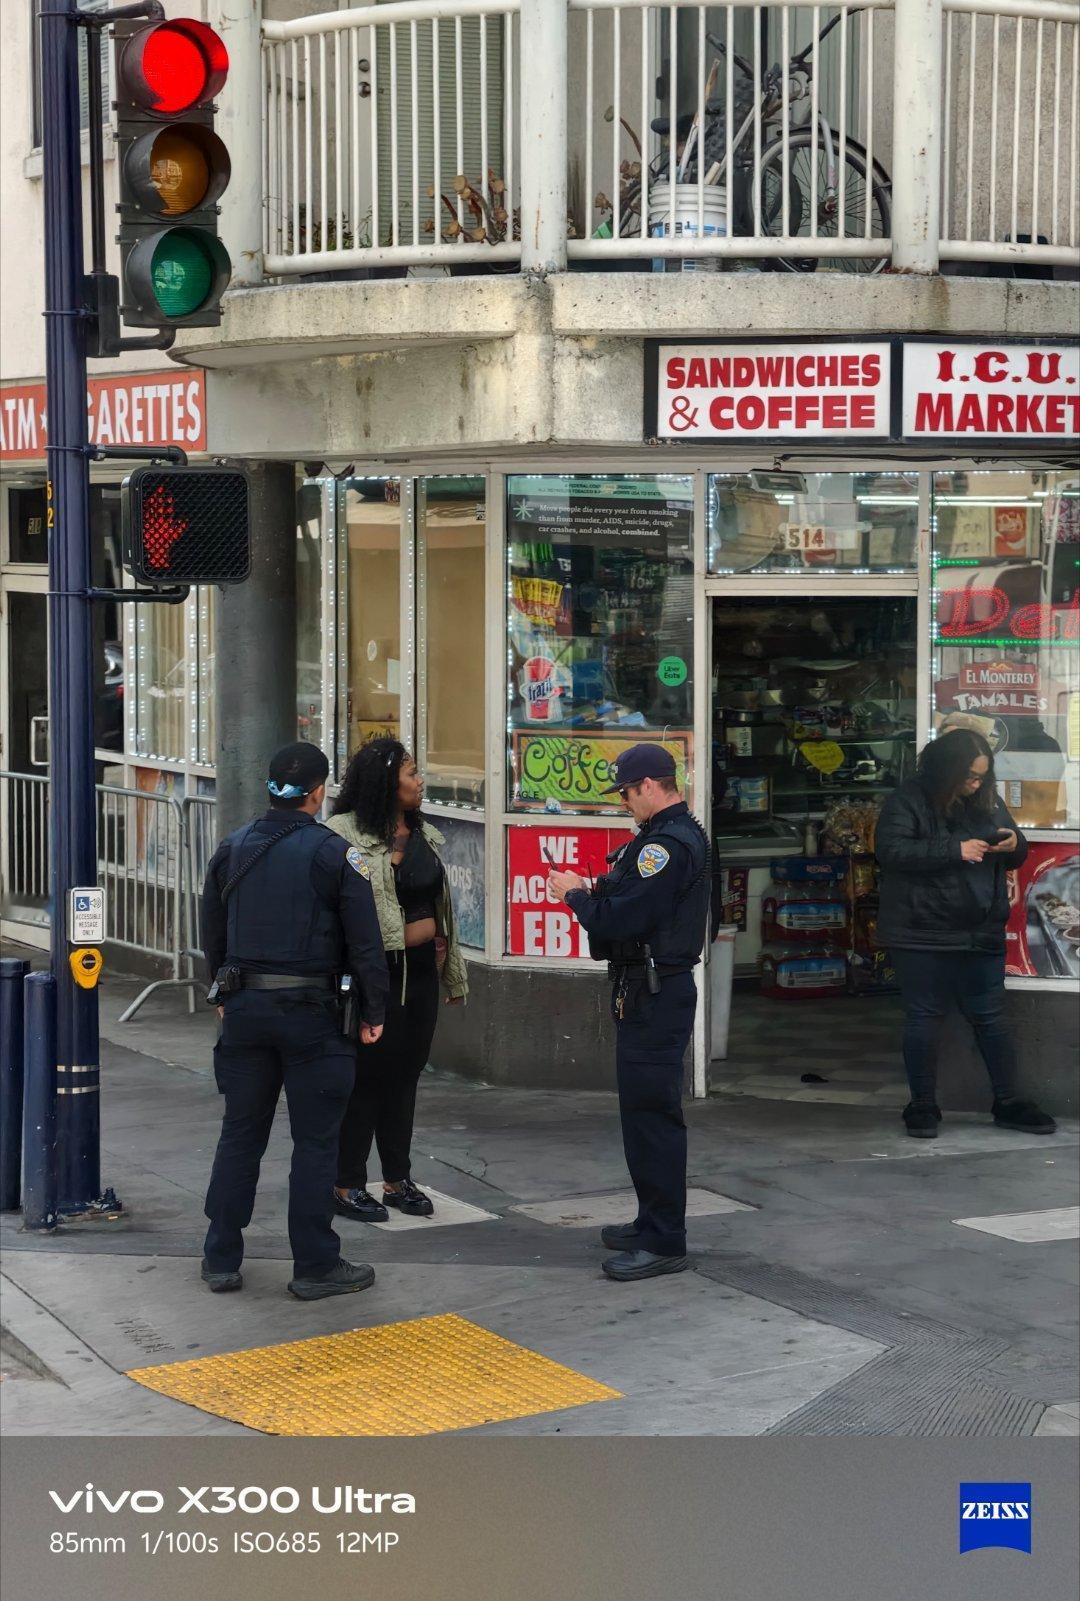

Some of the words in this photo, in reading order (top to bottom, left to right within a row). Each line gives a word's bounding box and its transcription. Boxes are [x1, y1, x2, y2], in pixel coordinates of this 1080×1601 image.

[666, 354, 881, 389] SANDWICHES
[937, 350, 1076, 385] I.C.U.
[669, 395, 699, 432] &
[709, 394, 876, 430] COFFEE
[559, 504, 581, 514] people
[583, 504, 593, 513] die
[630, 507, 647, 515] from
[648, 509, 679, 517] smoking
[550, 526, 579, 534] crashes,
[593, 527, 621, 536] alcohol,
[621, 528, 661, 536] combined.
[556, 515, 573, 523] from
[603, 517, 624, 525] AIDS,
[625, 517, 651, 526] suicide,
[652, 519, 675, 528] drugs,
[788, 528, 824, 548] 514
[980, 669, 1036, 684] MONTEREY
[952, 691, 1048, 712] TAMALES
[539, 835, 579, 865] WE
